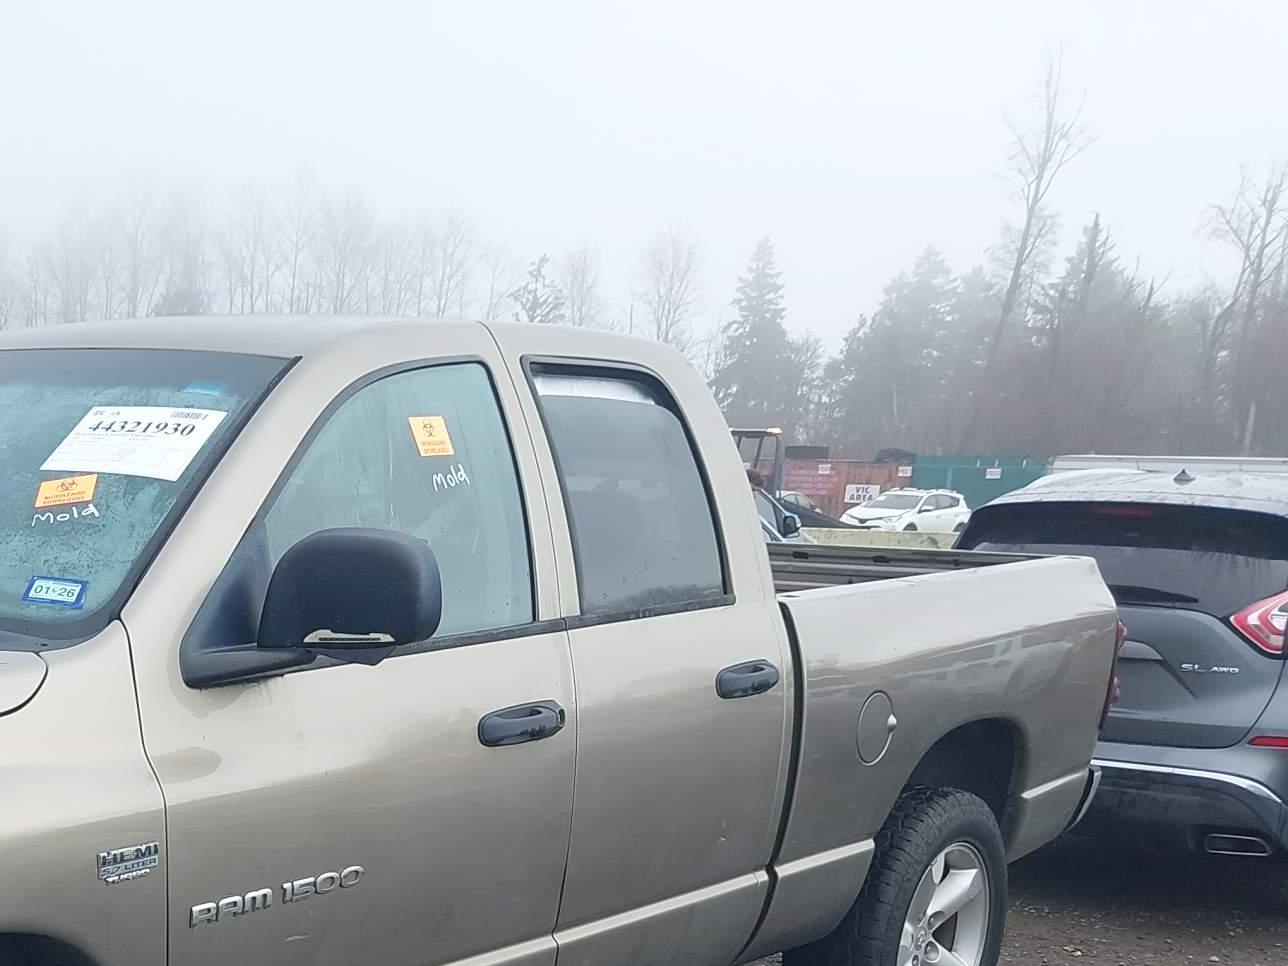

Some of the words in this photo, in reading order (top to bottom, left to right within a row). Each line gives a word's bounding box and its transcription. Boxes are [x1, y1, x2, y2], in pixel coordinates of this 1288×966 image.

[88, 420, 196, 436] 44321930
[432, 464, 470, 492] Mold
[849, 494, 873, 502] AREA
[32, 504, 99, 527] Mold
[1181, 663, 1206, 673] SL
[1209, 666, 1239, 674] AWD
[98, 842, 159, 865] HEMI
[124, 856, 157, 870] LITER
[189, 887, 273, 928] RAM
[281, 865, 365, 904] 1500
